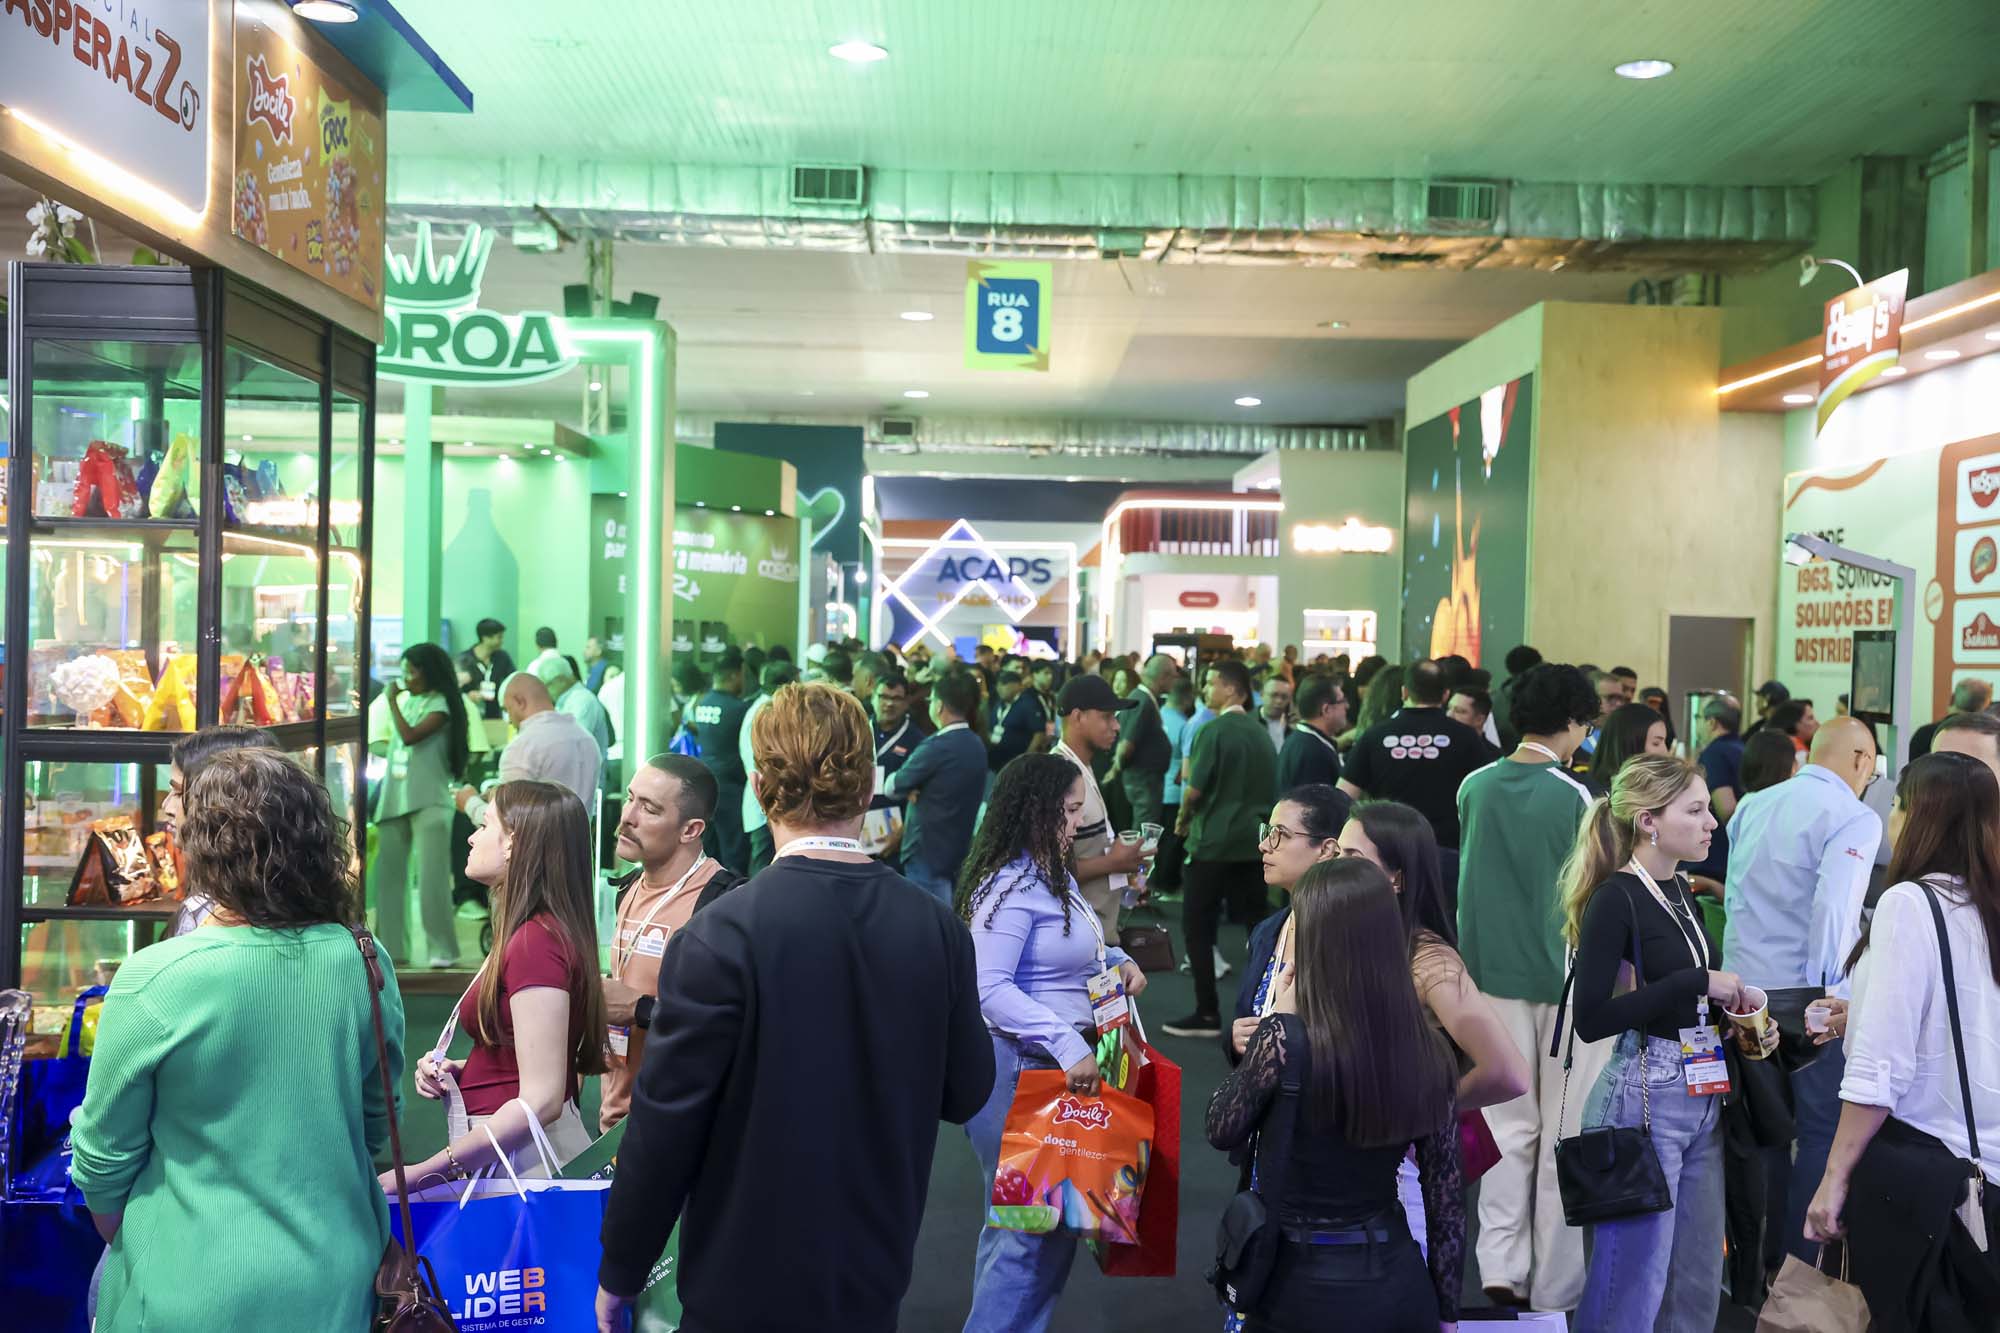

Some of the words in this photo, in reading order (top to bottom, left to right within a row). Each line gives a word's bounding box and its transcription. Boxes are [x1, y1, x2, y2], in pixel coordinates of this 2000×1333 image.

[987, 292, 1030, 307] RUA
[991, 307, 1023, 342] 8
[937, 555, 1051, 584] ACAPS
[1797, 565, 1832, 594] 1963,
[1796, 592, 1873, 632] SOLUÇÕES
[1062, 1102, 1103, 1122] Docile
[1044, 1133, 1077, 1147] doces
[465, 1267, 545, 1295] WEB
[461, 1322, 497, 1332] SISTEMA
[499, 1319, 510, 1328] DE
[511, 1316, 545, 1326] GESTÃO
